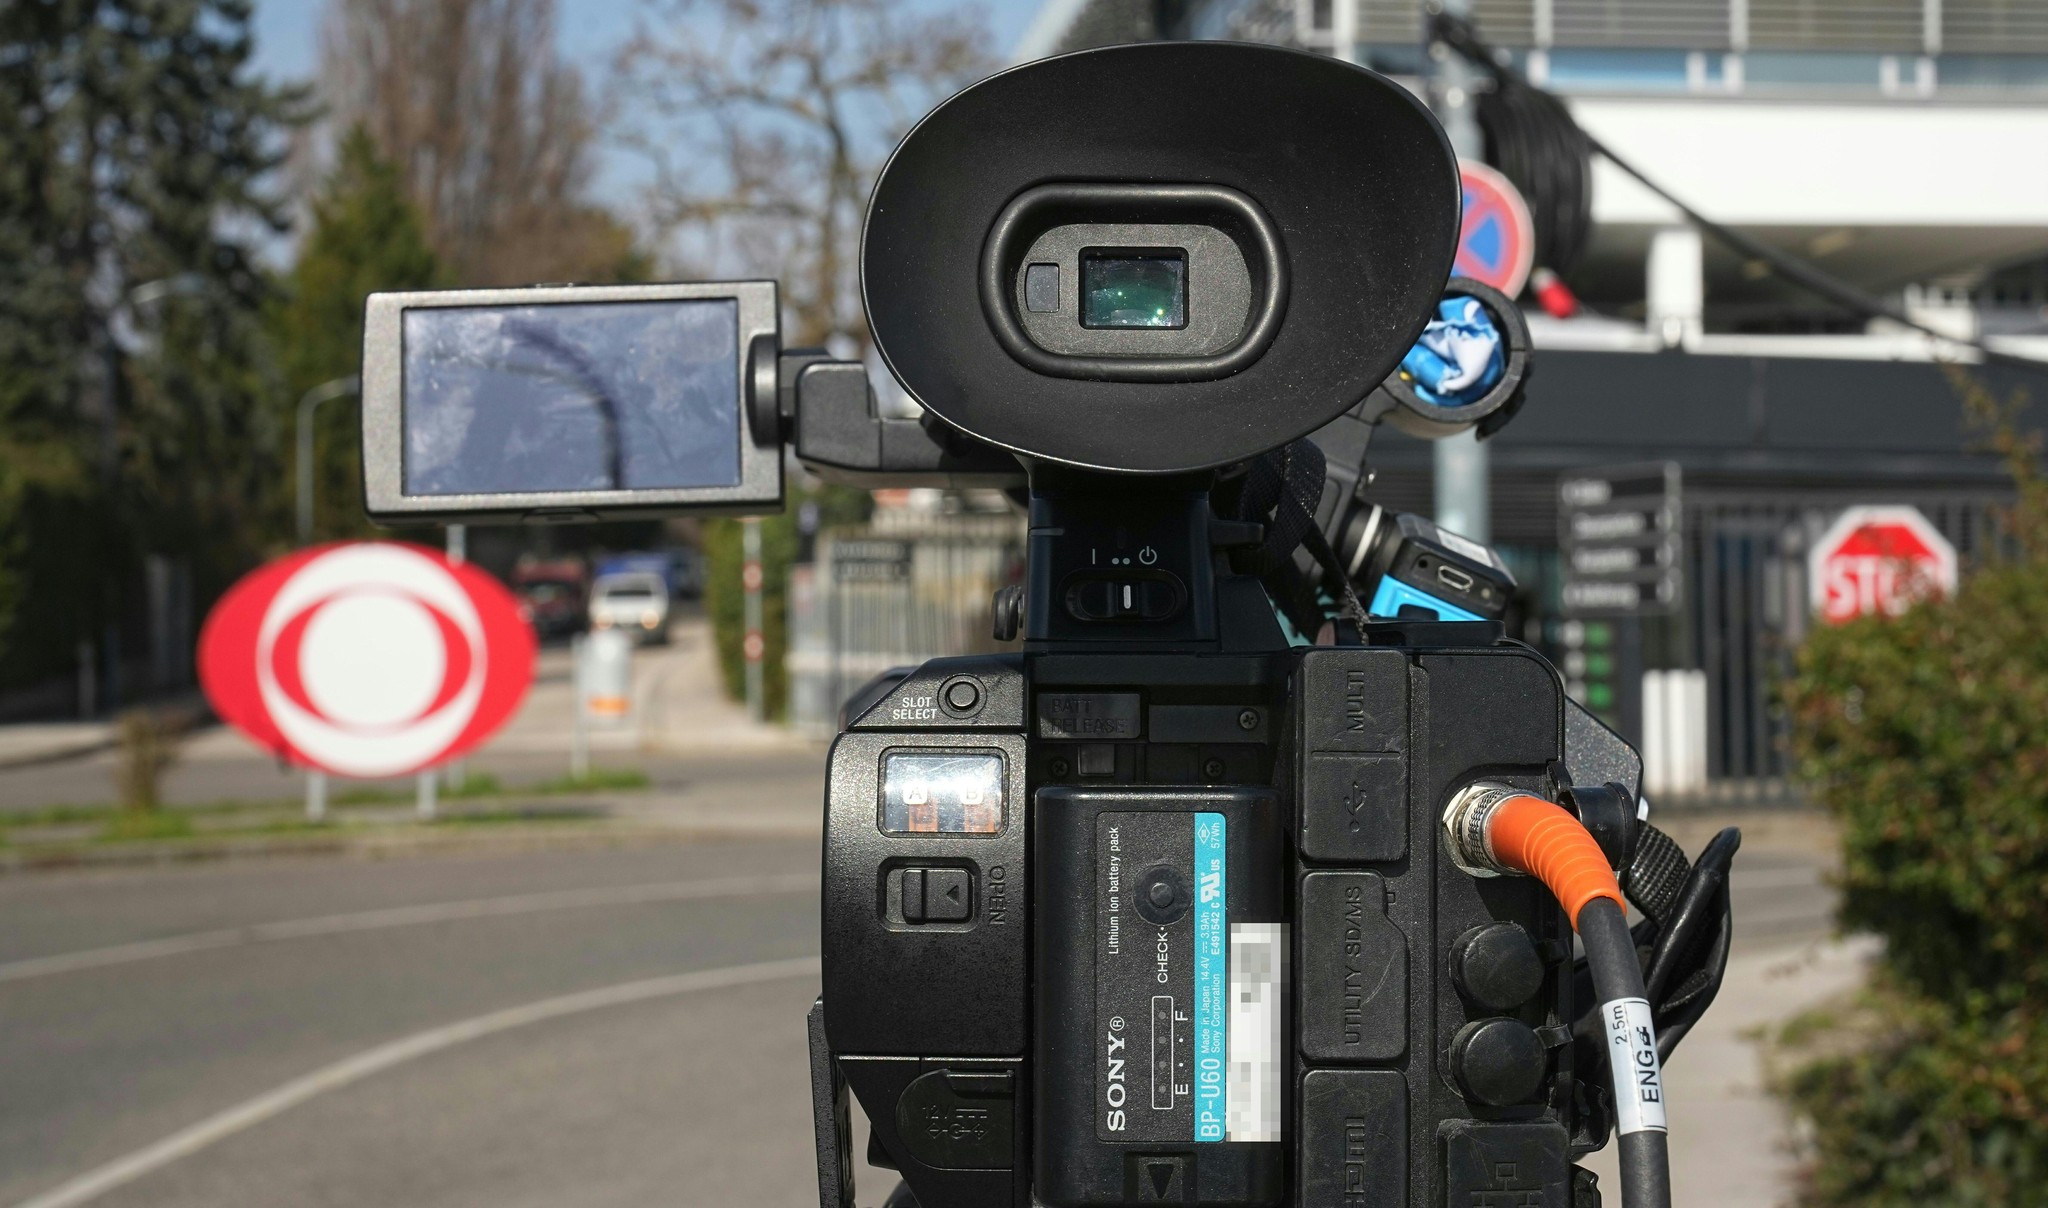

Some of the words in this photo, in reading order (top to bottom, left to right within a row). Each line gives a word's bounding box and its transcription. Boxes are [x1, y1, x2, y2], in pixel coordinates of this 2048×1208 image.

[892, 708, 937, 720] SELECT
[902, 697, 932, 708] SLOT
[1051, 699, 1092, 713] BATT
[1346, 670, 1364, 733] MULTI
[1051, 719, 1125, 734] RELEASE
[1108, 826, 1121, 852] pack
[1211, 822, 1220, 849] 57Wh
[1108, 855, 1121, 893] battery
[989, 865, 1006, 926] OPEN
[1108, 897, 1119, 912] ion
[1108, 916, 1119, 954] Lithium
[1201, 911, 1210, 939] 3.9Ah
[1211, 911, 1220, 955] E491542
[1345, 886, 1361, 958] SD/MS
[1157, 932, 1168, 983] CHECK
[1201, 956, 1210, 981] 14.4V
[1201, 985, 1212, 1013] Japan
[1211, 973, 1222, 1027] Corporation
[1345, 965, 1361, 1046] UTILITY
[1175, 1010, 1189, 1021] F
[1201, 1016, 1210, 1025] in
[1612, 1005, 1628, 1045] 2.5m
[1201, 1028, 1210, 1054] Made
[1211, 1030, 1222, 1054] Sony
[1175, 1083, 1189, 1095] E
[1636, 1050, 1660, 1103] ENG
[1200, 1058, 1221, 1137] BP-U60
